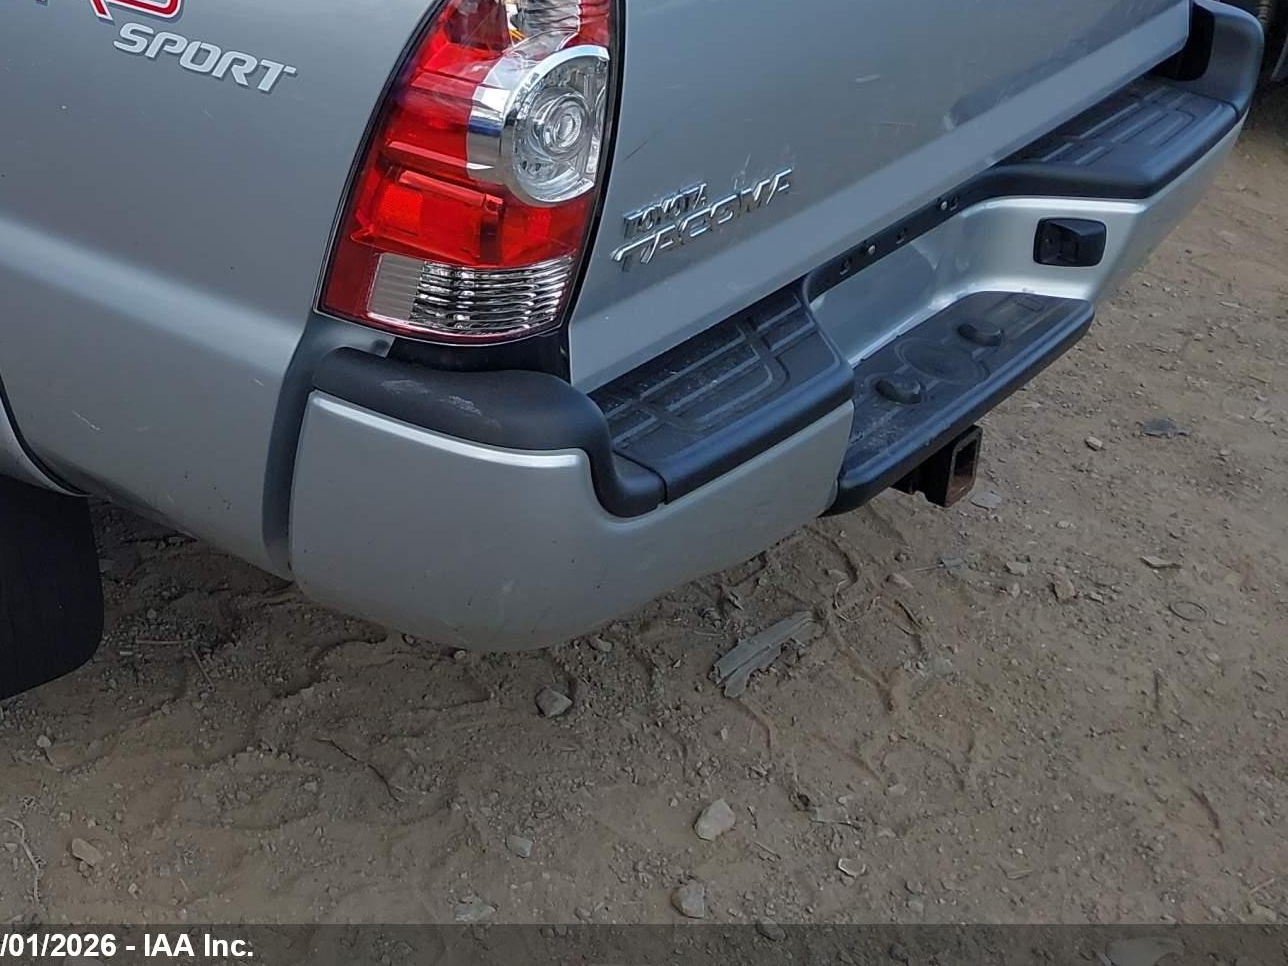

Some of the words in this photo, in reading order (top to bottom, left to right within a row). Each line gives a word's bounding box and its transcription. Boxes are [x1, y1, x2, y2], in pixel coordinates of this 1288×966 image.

[113, 22, 297, 92] SPORT
[611, 168, 793, 272] TACOMA
[622, 182, 707, 240] TOYOTA
